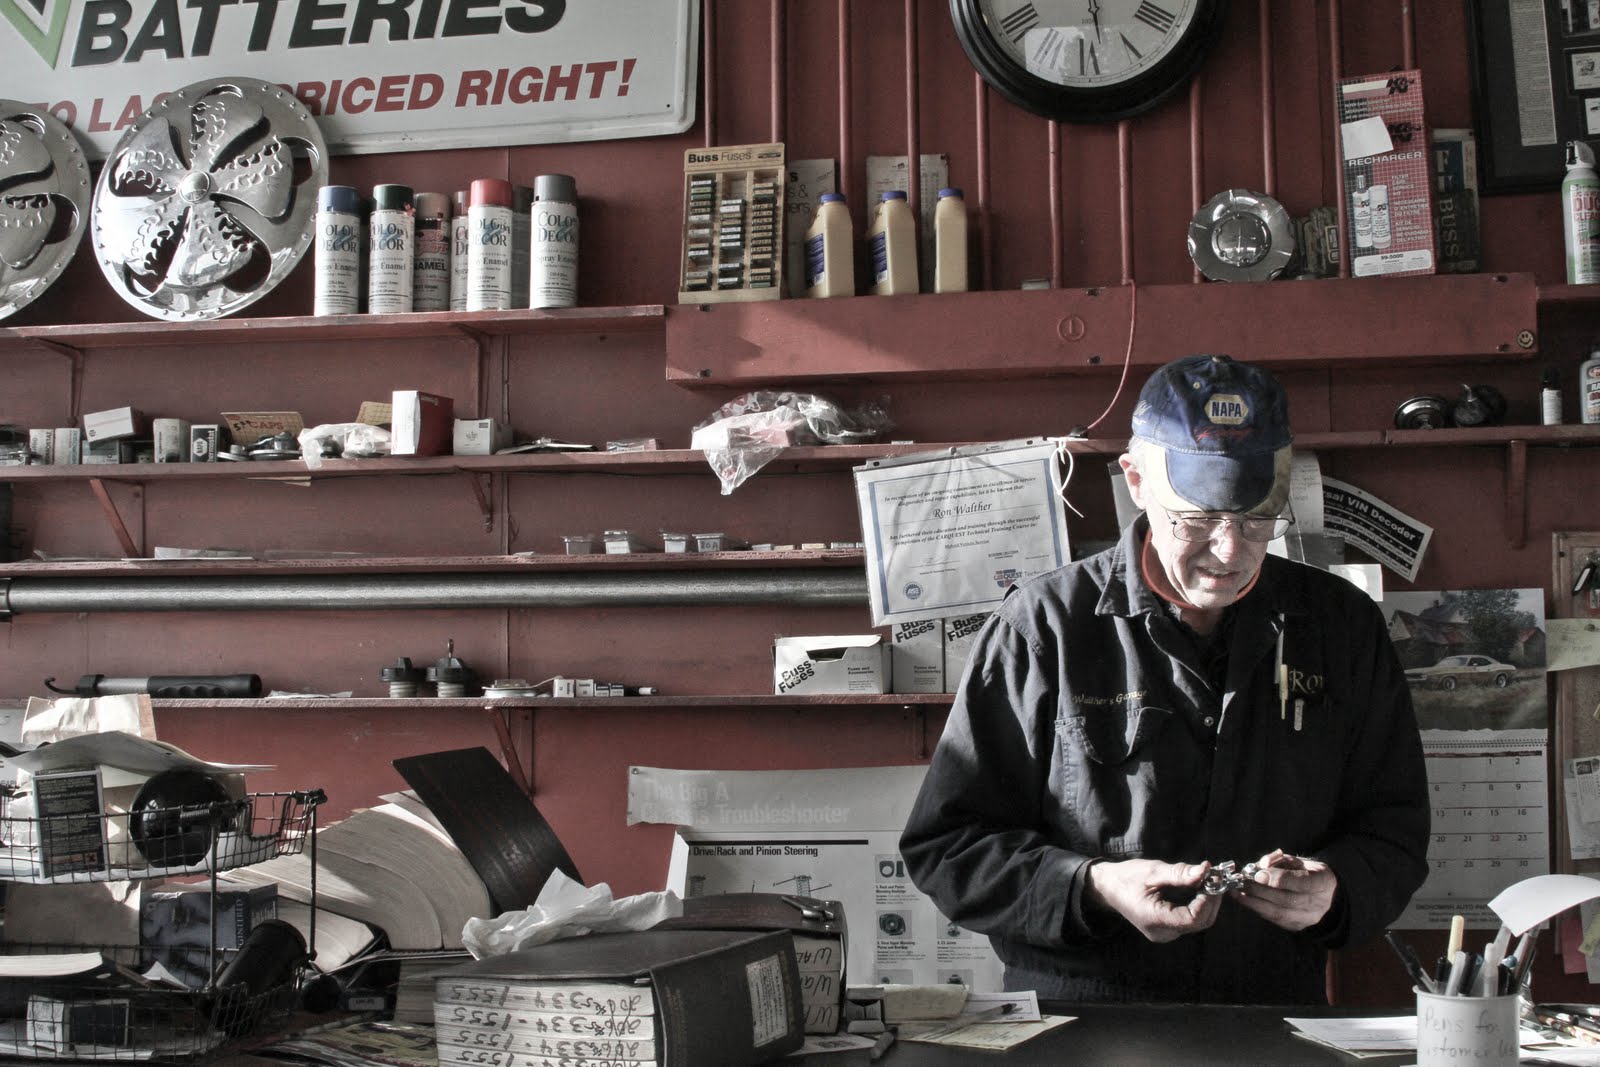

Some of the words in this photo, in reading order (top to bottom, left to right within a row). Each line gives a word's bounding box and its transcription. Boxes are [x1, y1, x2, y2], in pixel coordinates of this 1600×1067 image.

[71, 0, 567, 67] BATTERIES
[455, 58, 637, 107] RIGHT!
[688, 153, 718, 164] Buss
[720, 151, 752, 161] Fuses
[1348, 151, 1422, 167] RECHARGER
[1212, 402, 1242, 418] NAPA
[933, 508, 952, 518] Ron
[954, 501, 992, 514] Walther
[1347, 496, 1368, 513] VIN
[1370, 507, 1416, 541] Decoder
[952, 612, 985, 631] Buss
[895, 622, 936, 644] Fuses
[1115, 690, 1148, 704] Garage
[715, 802, 850, 824] Troubleshooter
[739, 846, 754, 856] and
[756, 846, 782, 856] Pinion
[784, 845, 818, 857] Steering
[1424, 1006, 1465, 1033] Pens
